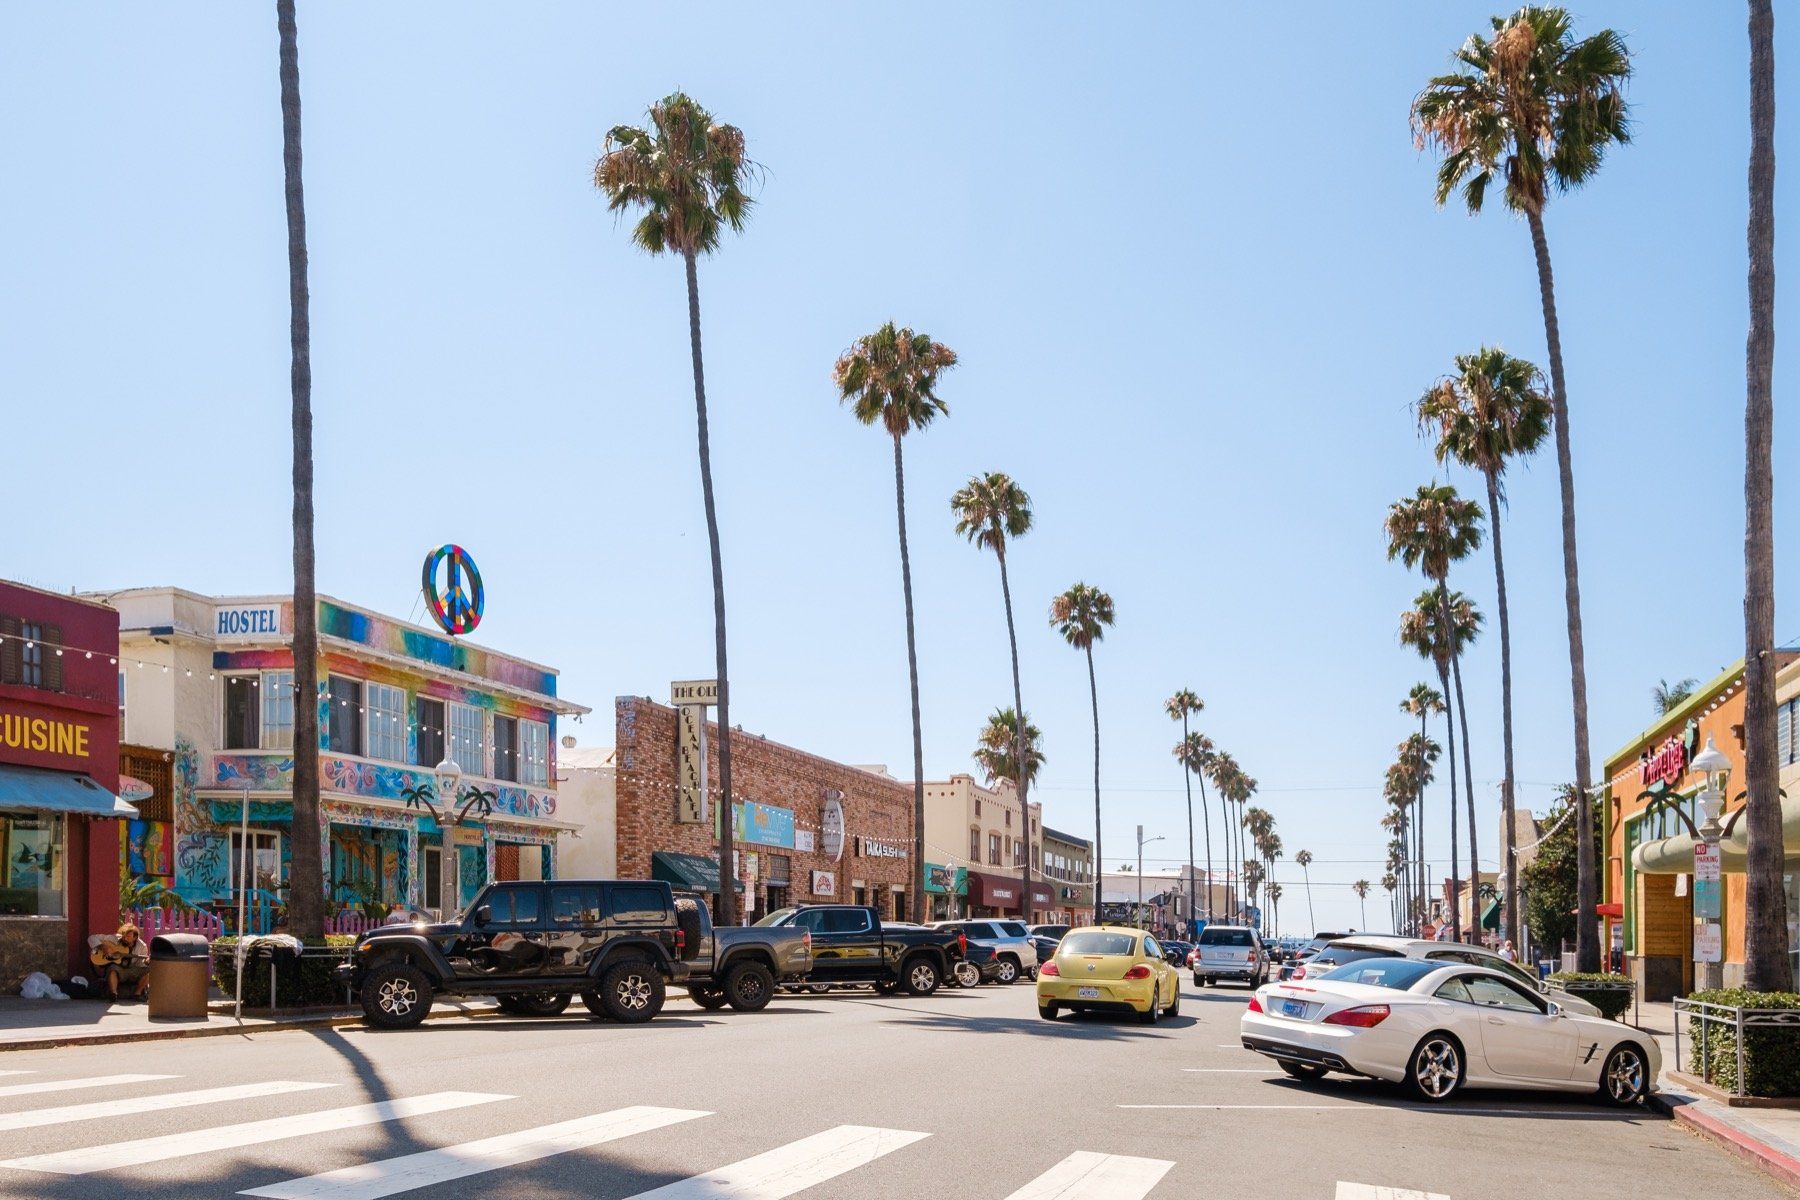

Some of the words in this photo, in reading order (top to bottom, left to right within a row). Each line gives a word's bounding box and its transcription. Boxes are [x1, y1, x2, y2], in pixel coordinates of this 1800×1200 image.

[218, 609, 277, 634] HOSTEL
[674, 686, 695, 698] THE
[0, 714, 90, 757] UISINE
[681, 706, 699, 751] OCEAN
[682, 746, 699, 790] BEACH
[682, 785, 699, 820] CAFE
[1696, 845, 1706, 854] NO
